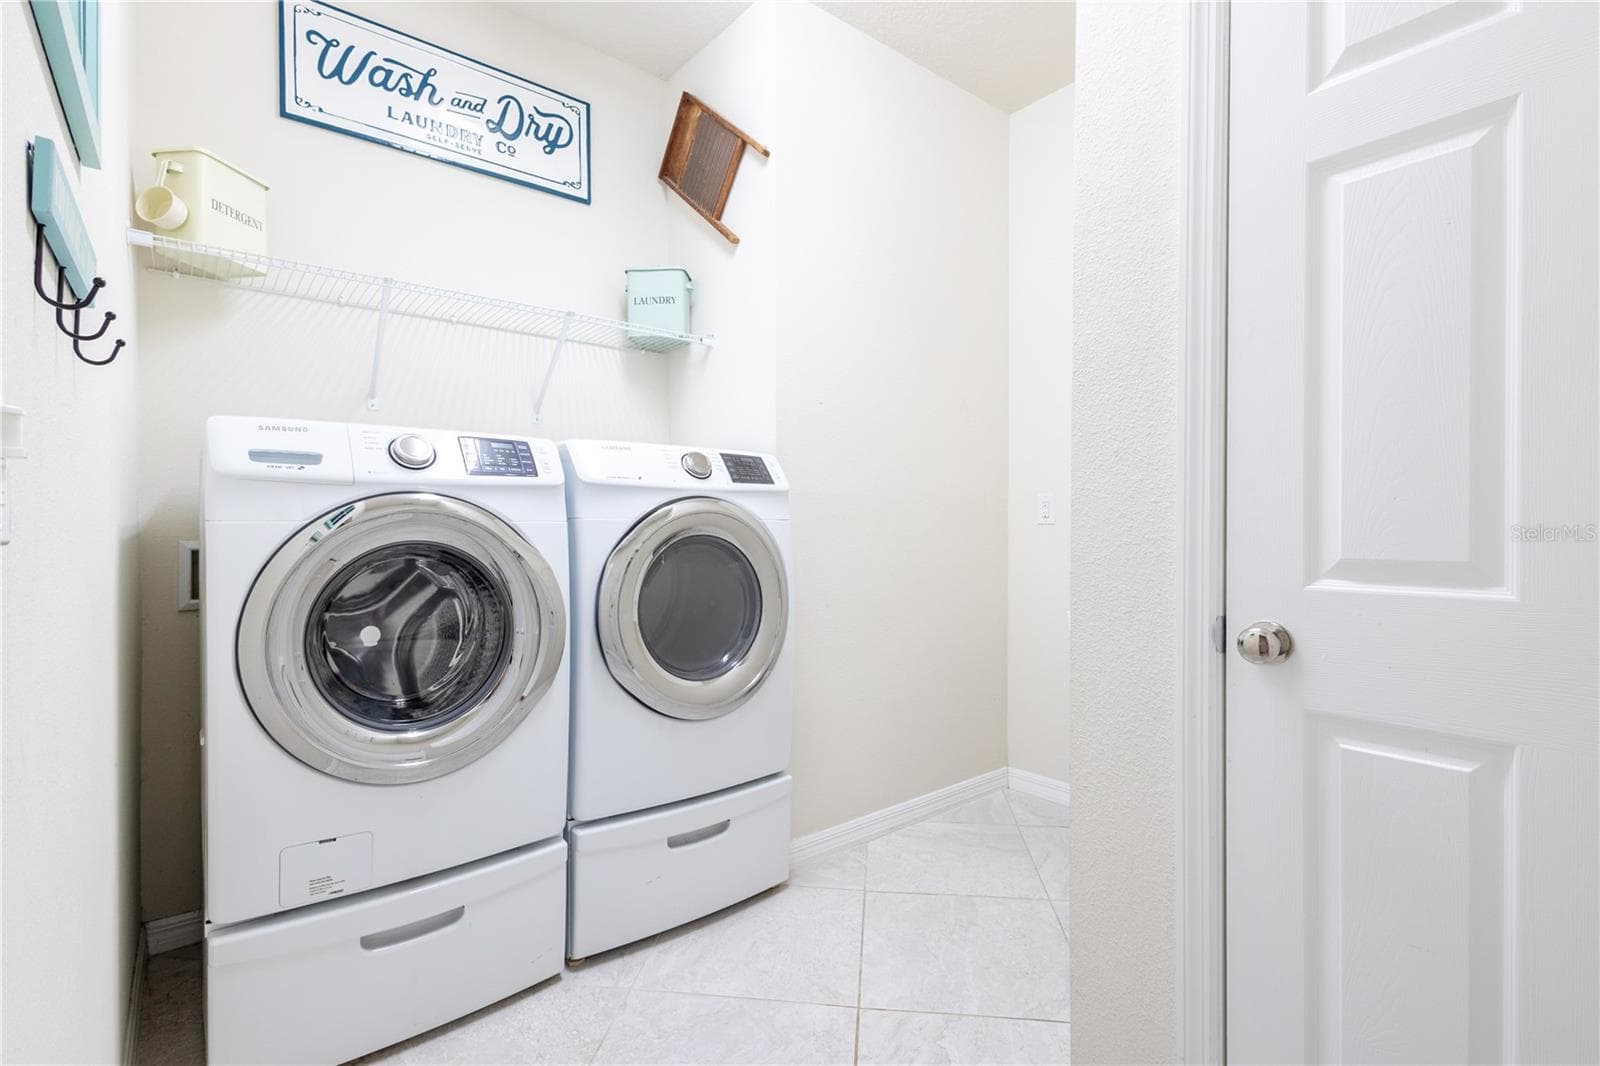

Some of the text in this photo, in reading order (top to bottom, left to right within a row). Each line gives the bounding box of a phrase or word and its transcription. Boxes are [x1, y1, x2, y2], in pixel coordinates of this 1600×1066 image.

[306, 29, 574, 155] Wash and Dry
[387, 105, 484, 147] LAUNDRY
[211, 198, 263, 232] DETERGENT
[633, 296, 677, 305] LAUNDRY
[257, 425, 309, 433] SAMSUNG
